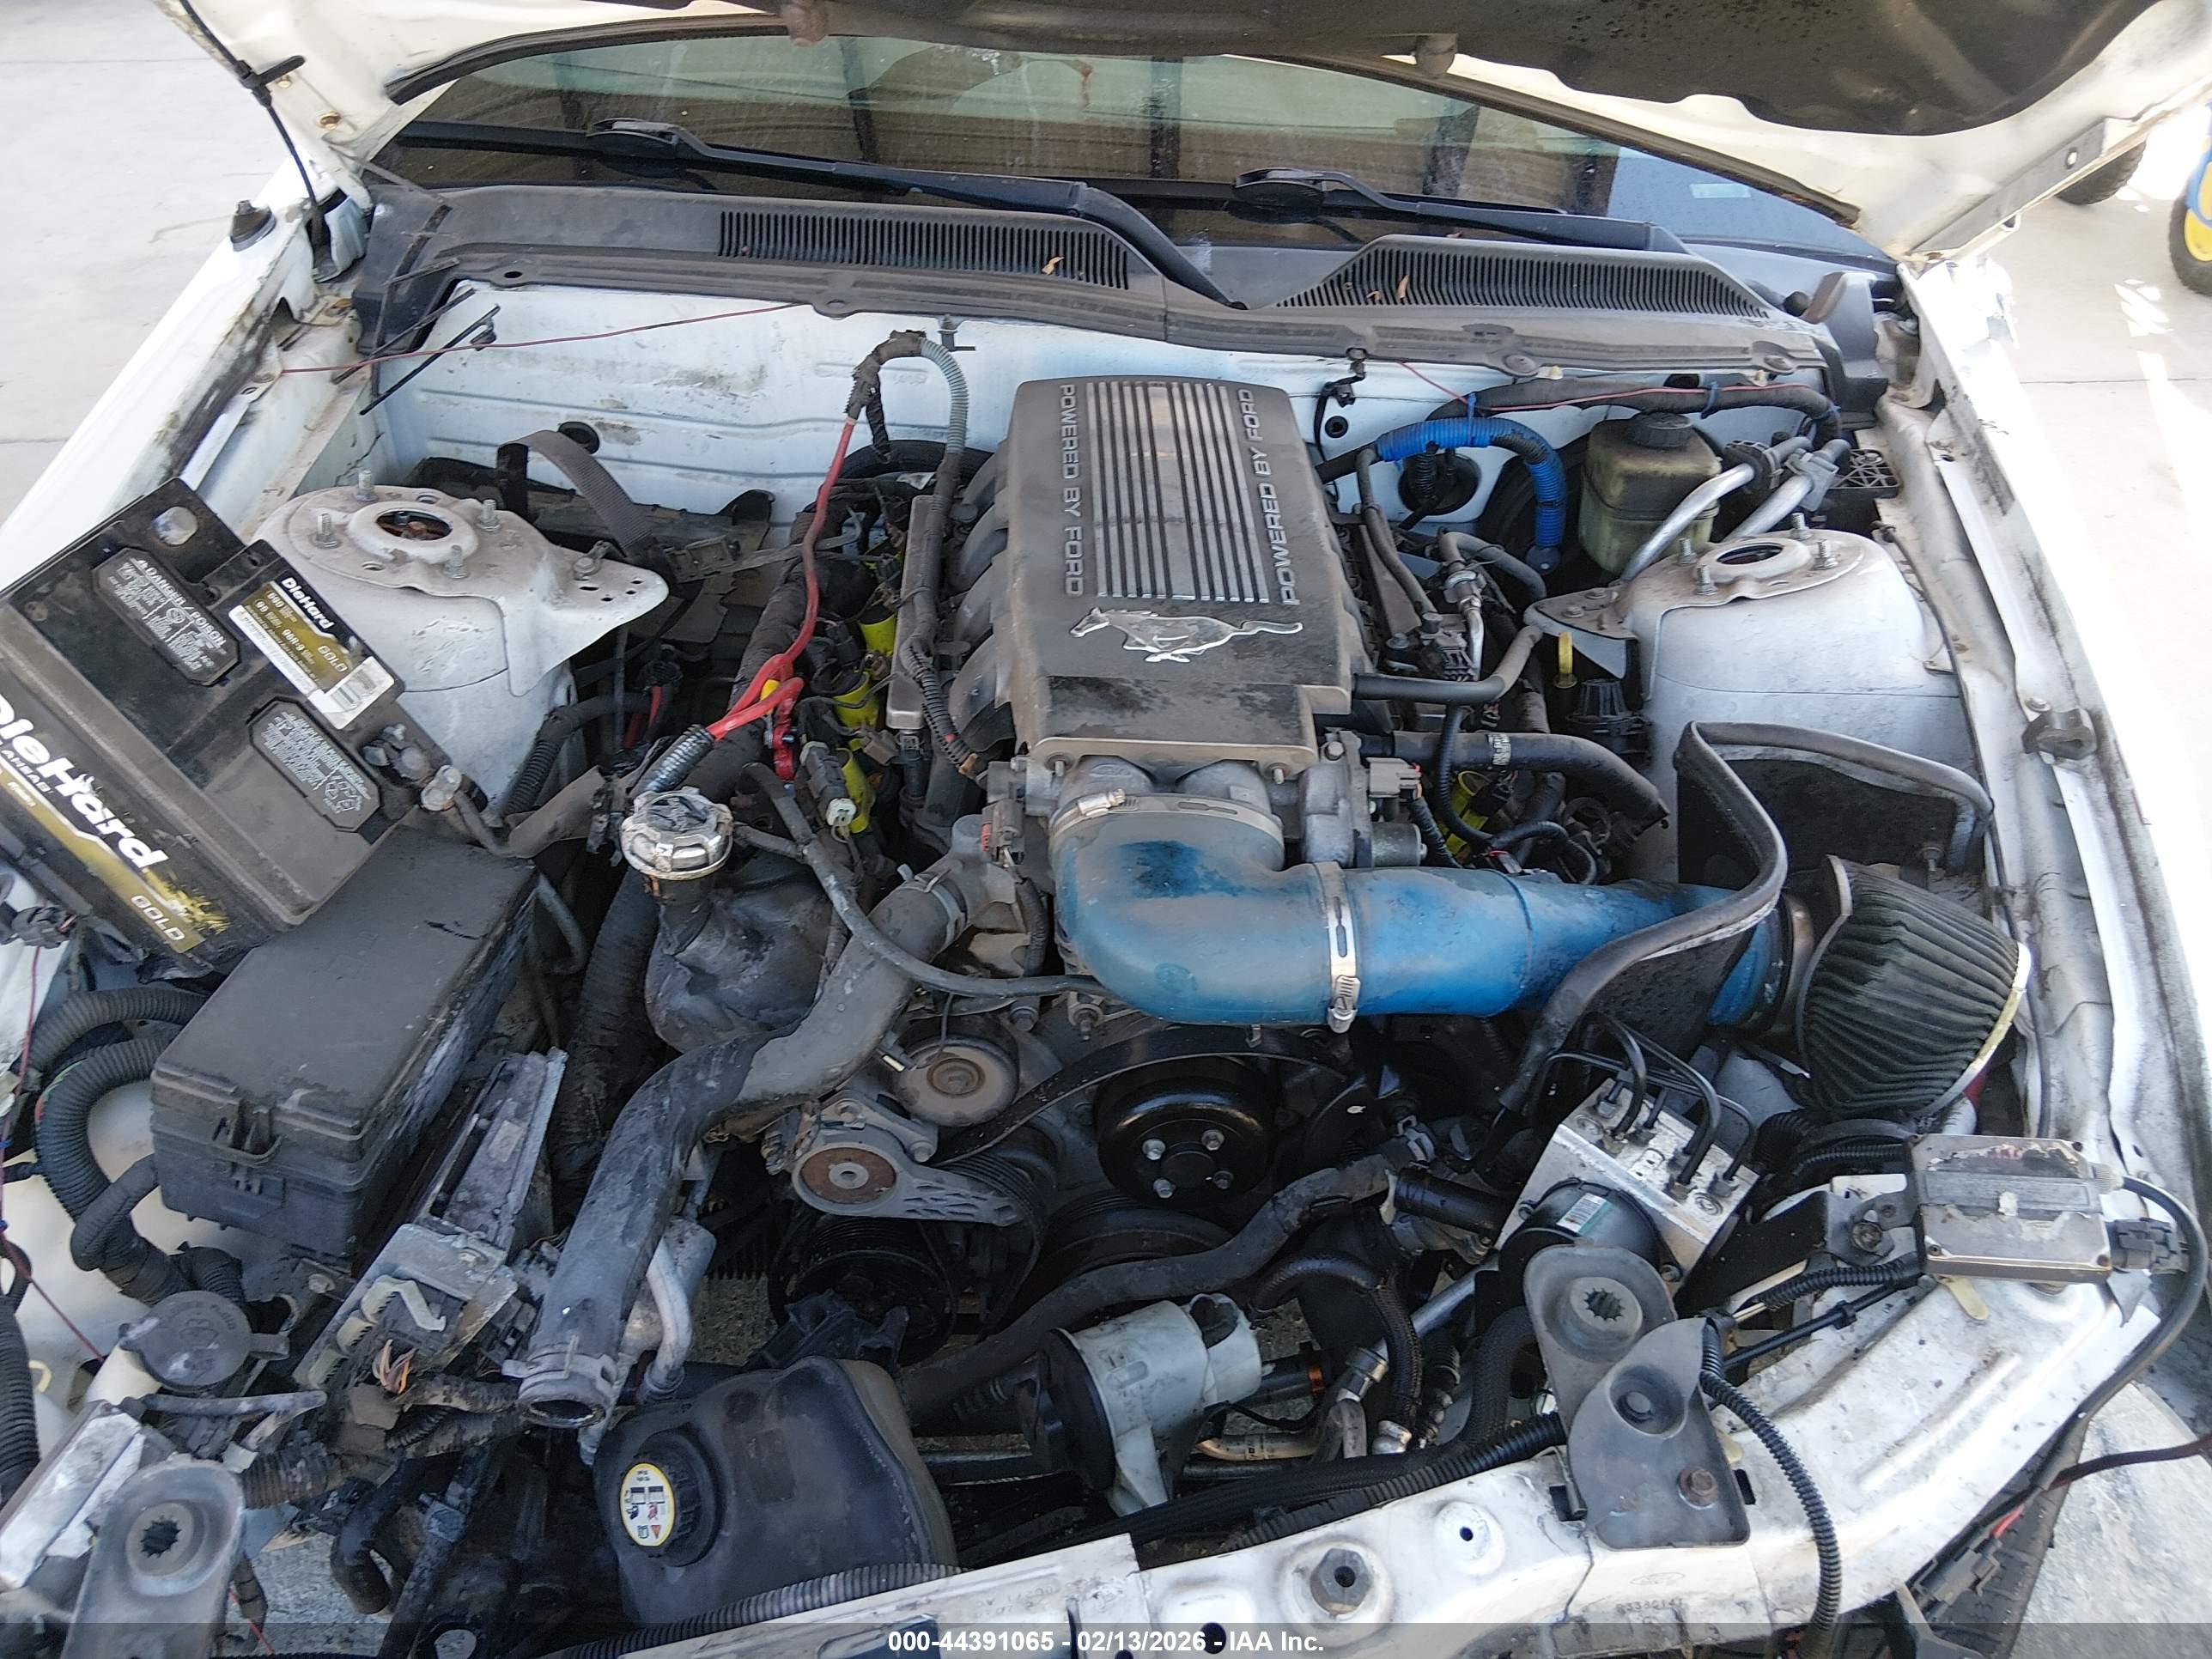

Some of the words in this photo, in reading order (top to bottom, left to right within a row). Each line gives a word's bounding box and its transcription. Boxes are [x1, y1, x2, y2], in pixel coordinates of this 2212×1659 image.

[1060, 384, 1079, 479] POWERED
[1237, 389, 1263, 441] FORD
[1249, 447, 1271, 476] BY
[1063, 487, 1081, 517] BY
[1064, 526, 1084, 597] FORD
[1258, 483, 1300, 605] POWERED
[145, 567, 186, 605] DANGER
[190, 611, 227, 645] POISON
[281, 576, 335, 629] DieHard
[317, 645, 348, 672] GOLD
[131, 895, 185, 941] GOLD
